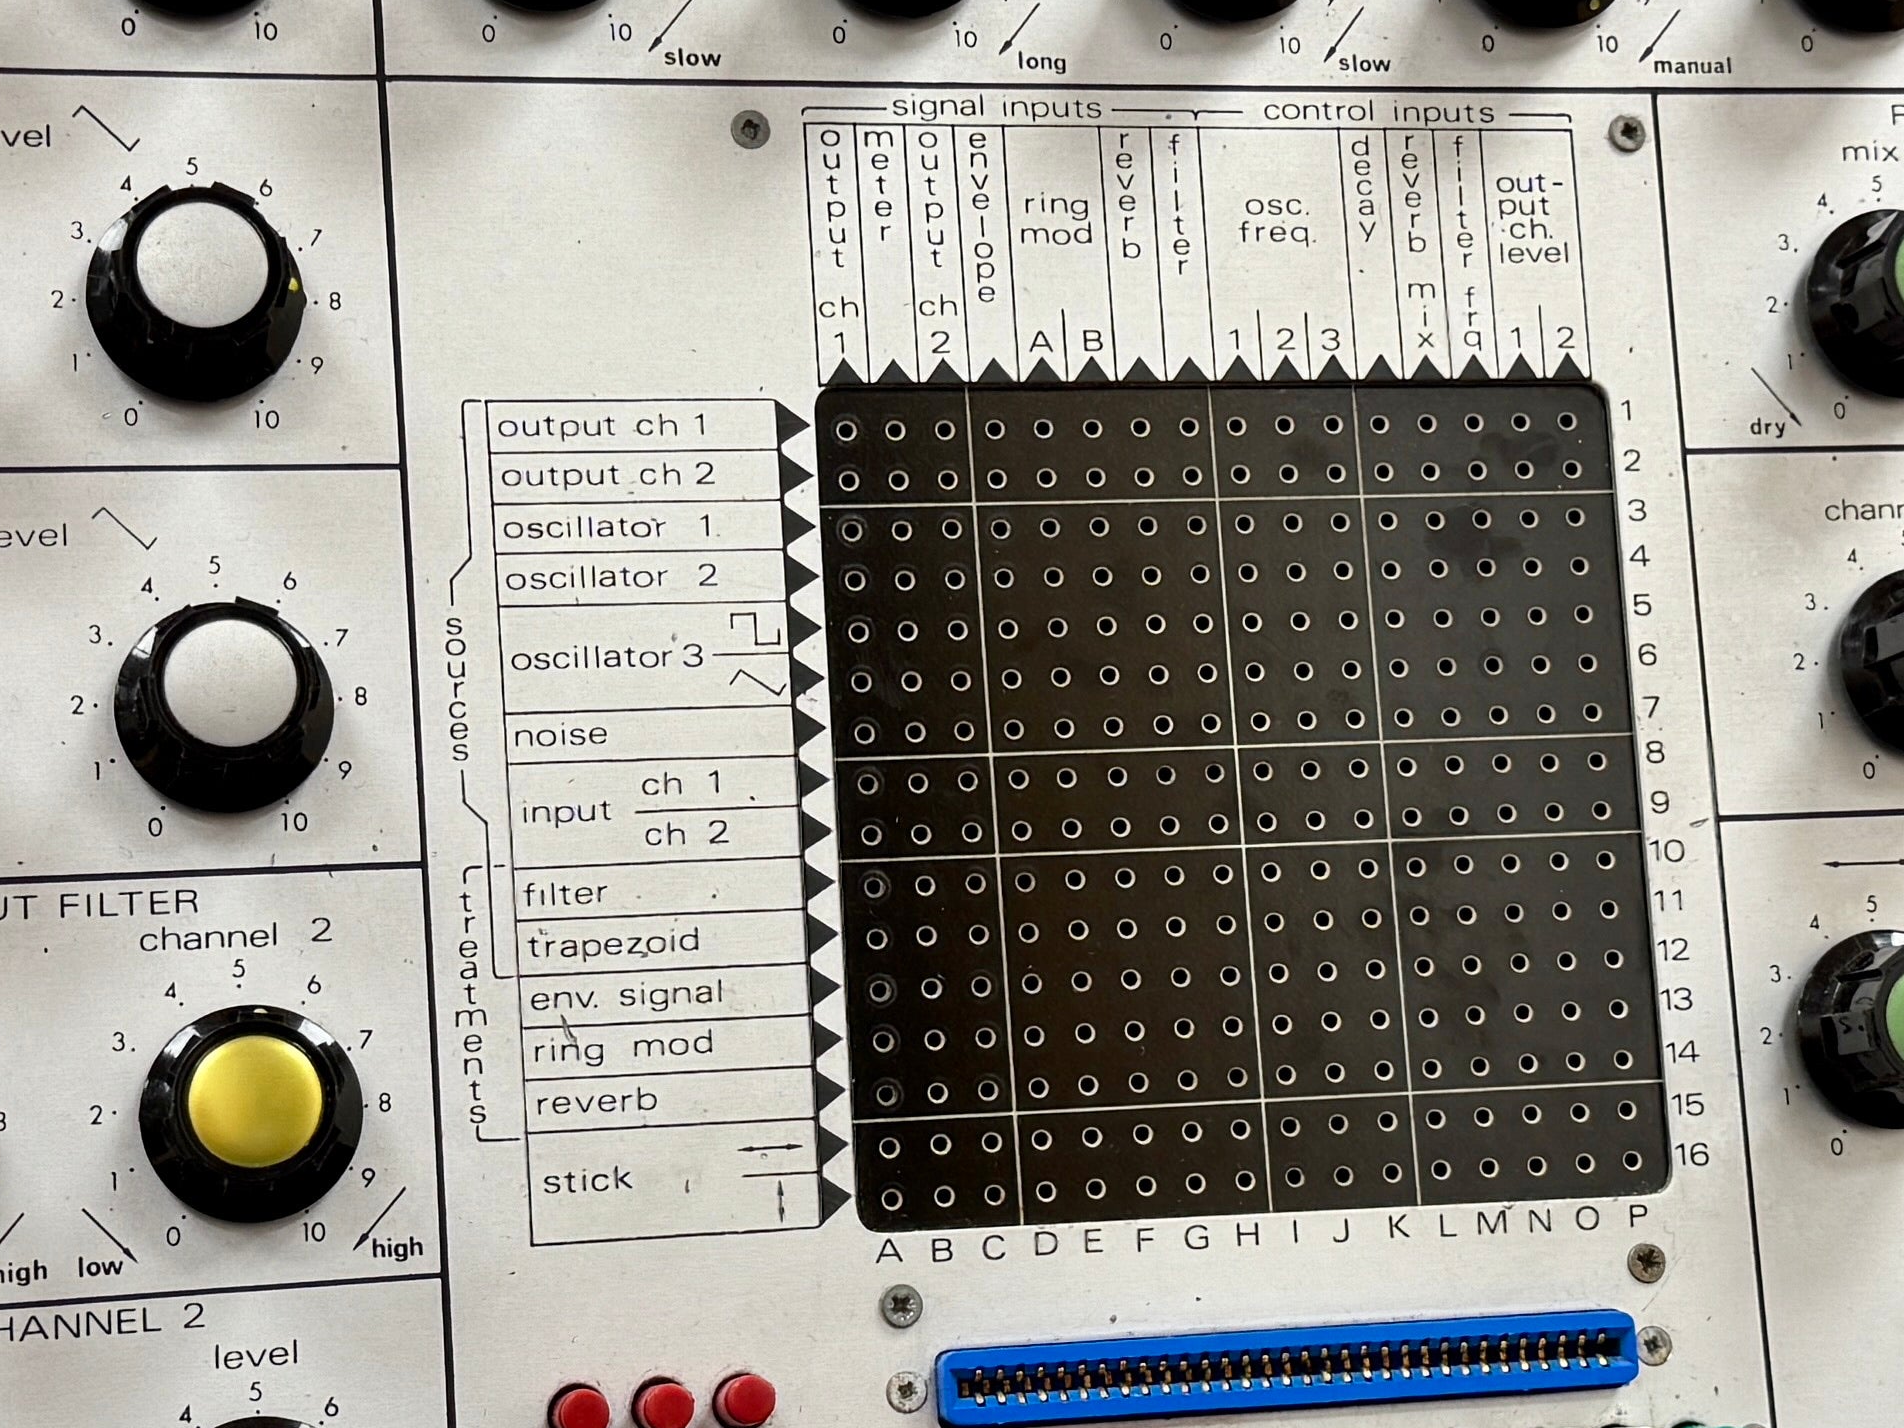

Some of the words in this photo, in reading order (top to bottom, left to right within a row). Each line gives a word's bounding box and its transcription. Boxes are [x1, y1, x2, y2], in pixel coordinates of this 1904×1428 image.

[663, 46, 723, 68] slow
[1017, 49, 1068, 76] long
[1652, 55, 1734, 76] manual
[891, 92, 985, 123] signal
[1001, 98, 1103, 124] inputs
[1262, 98, 1375, 123] control
[1392, 103, 1496, 128] inputs
[1840, 144, 1900, 163] mix
[862, 129, 895, 243] meter
[1114, 131, 1143, 260] reverb
[1350, 133, 1378, 244] decay
[1494, 172, 1565, 195] out-
[967, 131, 997, 304] envelope
[1023, 196, 1090, 223] ring
[1167, 132, 1192, 277] filter
[1497, 195, 1551, 222] put
[1019, 219, 1094, 247] mod
[1498, 240, 1570, 265] level
[496, 414, 617, 444] output
[634, 411, 679, 438] ch
[693, 412, 706, 437] 1
[1749, 416, 1787, 440] dry
[500, 464, 621, 492] output
[638, 460, 683, 487] ch
[694, 460, 717, 486] 2
[502, 514, 668, 541] oscillator
[699, 512, 711, 538] 1
[504, 564, 669, 592] oscillator
[697, 562, 720, 588] 2
[509, 644, 674, 672] oscillator
[681, 642, 705, 669] 3
[443, 616, 470, 763] sources
[513, 725, 609, 748] noise
[640, 770, 684, 797] ch
[707, 768, 721, 795] 1
[522, 799, 613, 830] input
[643, 820, 687, 847] ch
[707, 818, 731, 846] 2
[58, 888, 199, 920] FILTER
[521, 880, 609, 908] filter
[526, 925, 701, 964] trapezoid
[453, 890, 489, 1125] treatments
[618, 977, 724, 1014] signal
[535, 1085, 659, 1117] reverb
[542, 1164, 634, 1195] stick
[182, 1301, 207, 1330] 2
